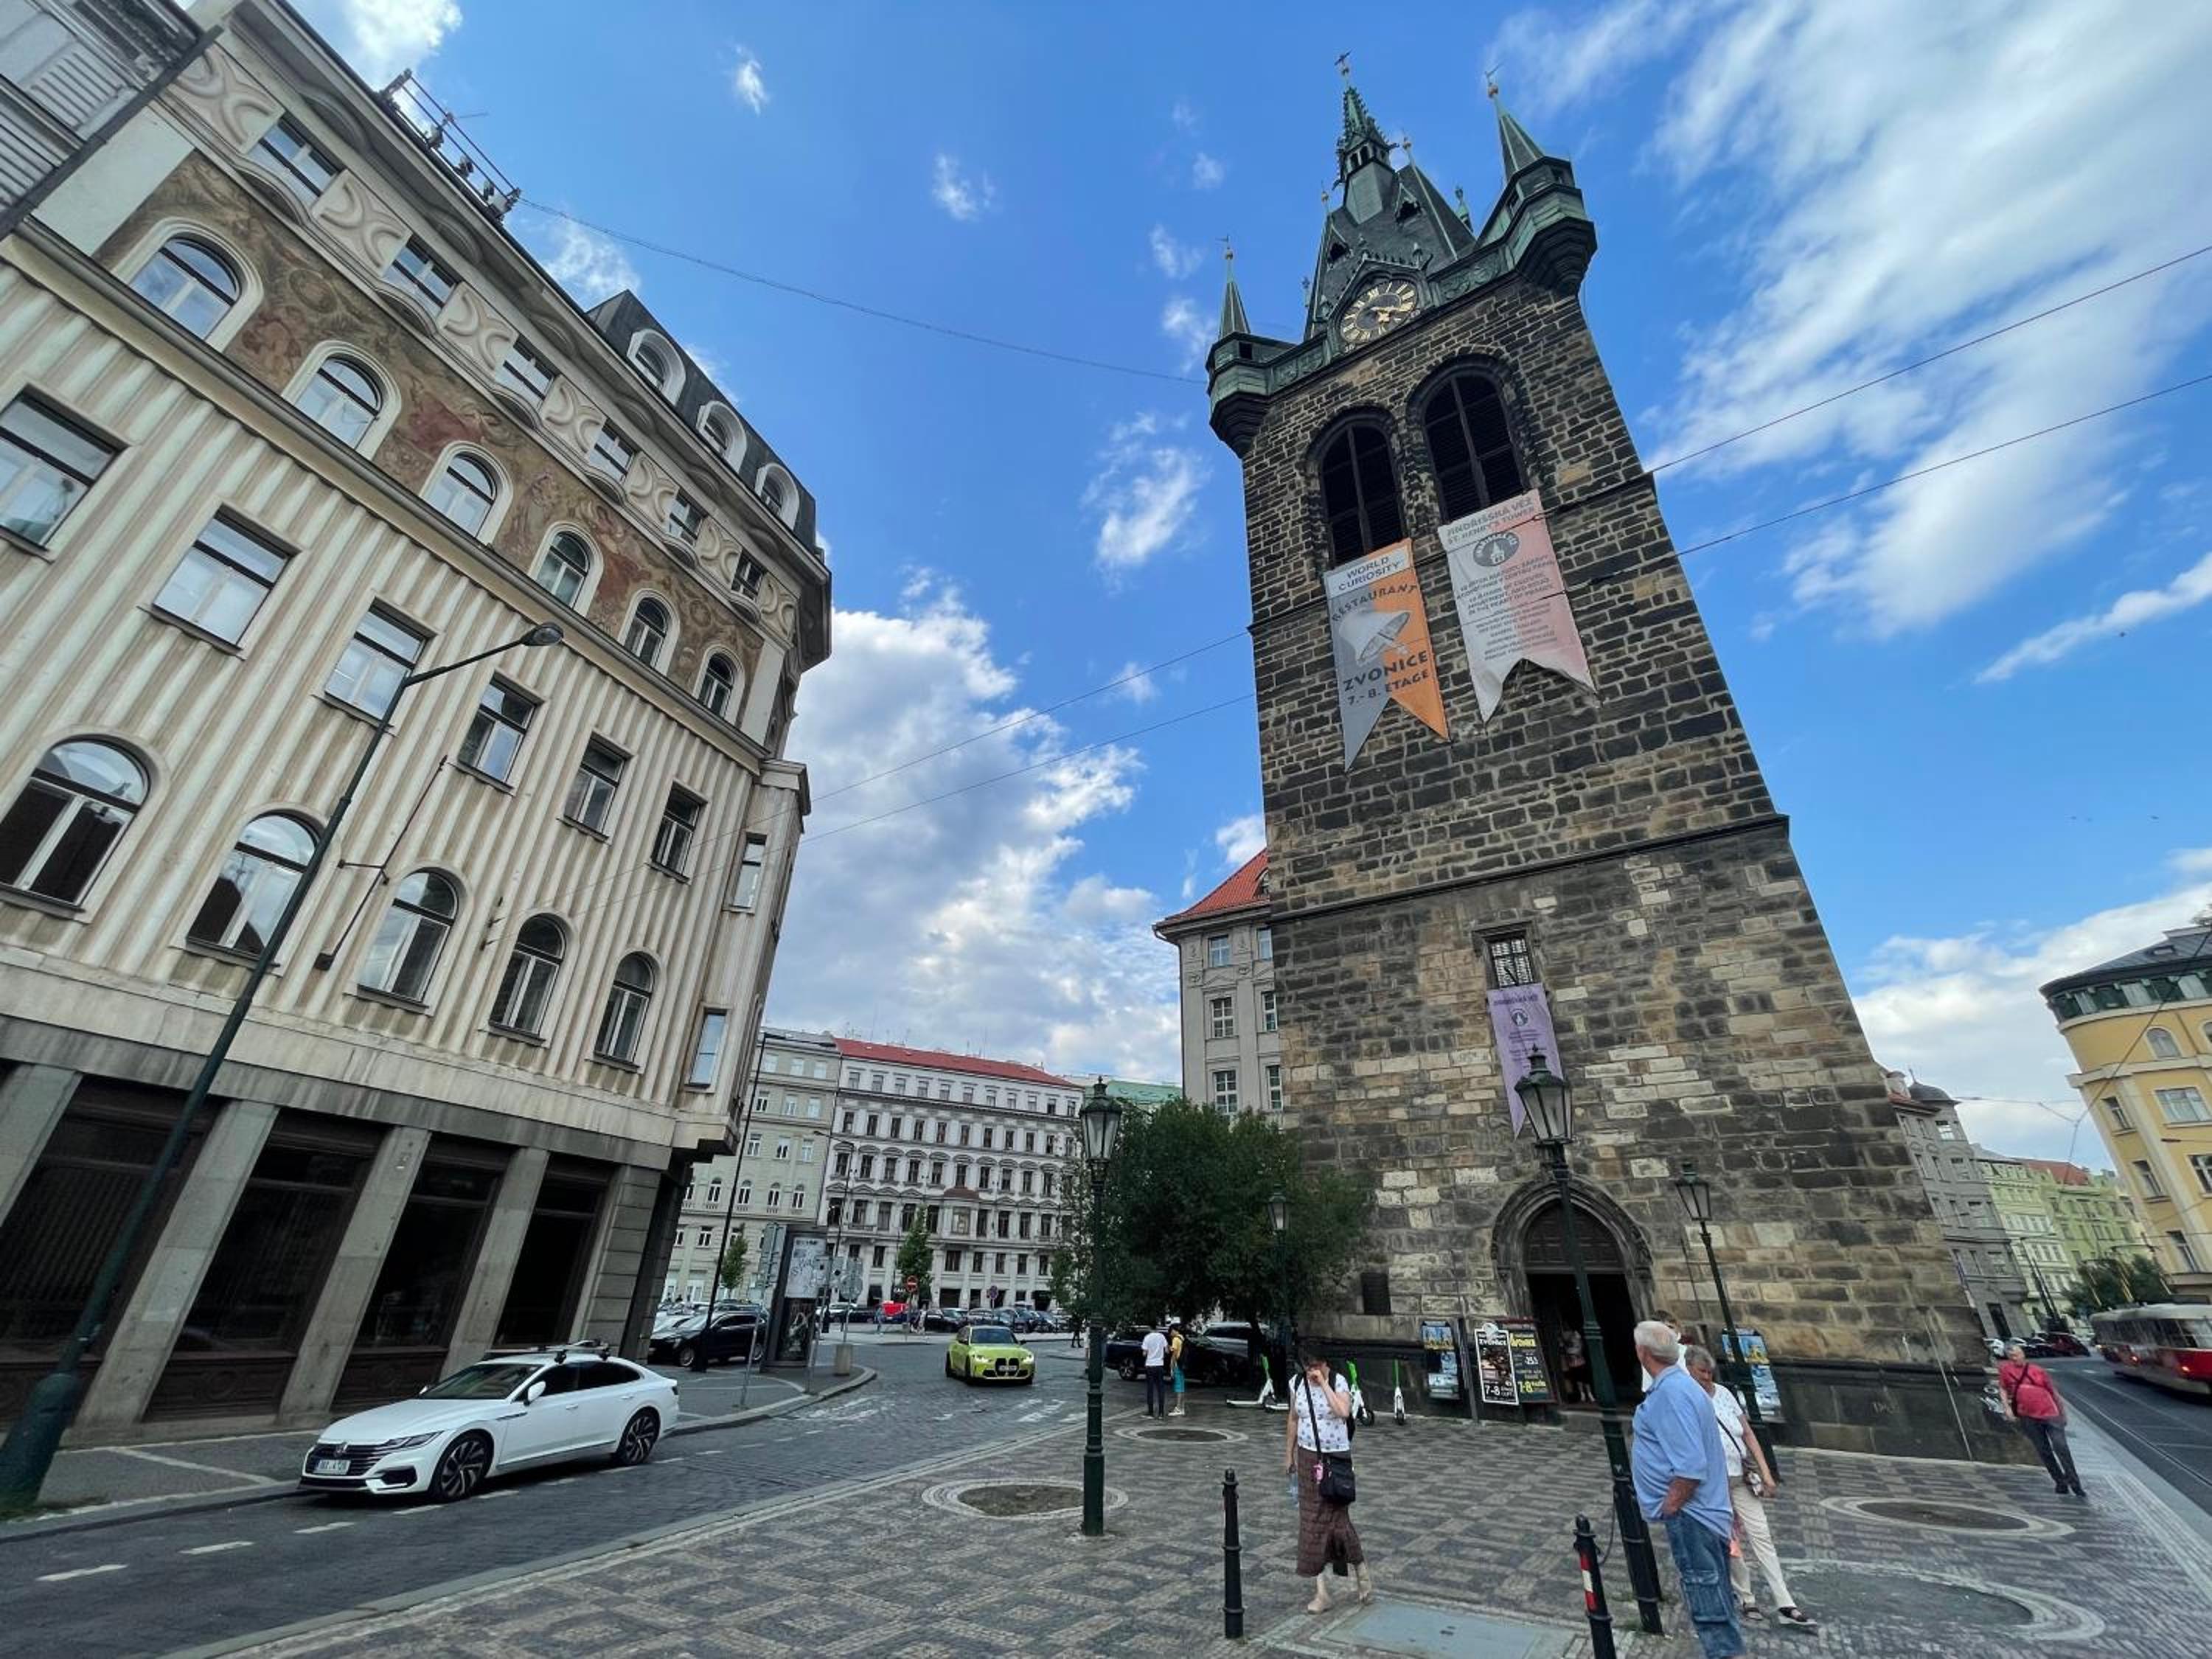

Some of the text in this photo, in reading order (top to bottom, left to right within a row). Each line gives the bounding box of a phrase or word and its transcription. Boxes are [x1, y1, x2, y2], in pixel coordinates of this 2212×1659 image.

[1338, 556, 1399, 591] WORLD CURIOSITY
[1332, 583, 1417, 622] RESTAURANT
[1343, 650, 1428, 692] ZVONICE
[1385, 669, 1429, 692] ETAGE
